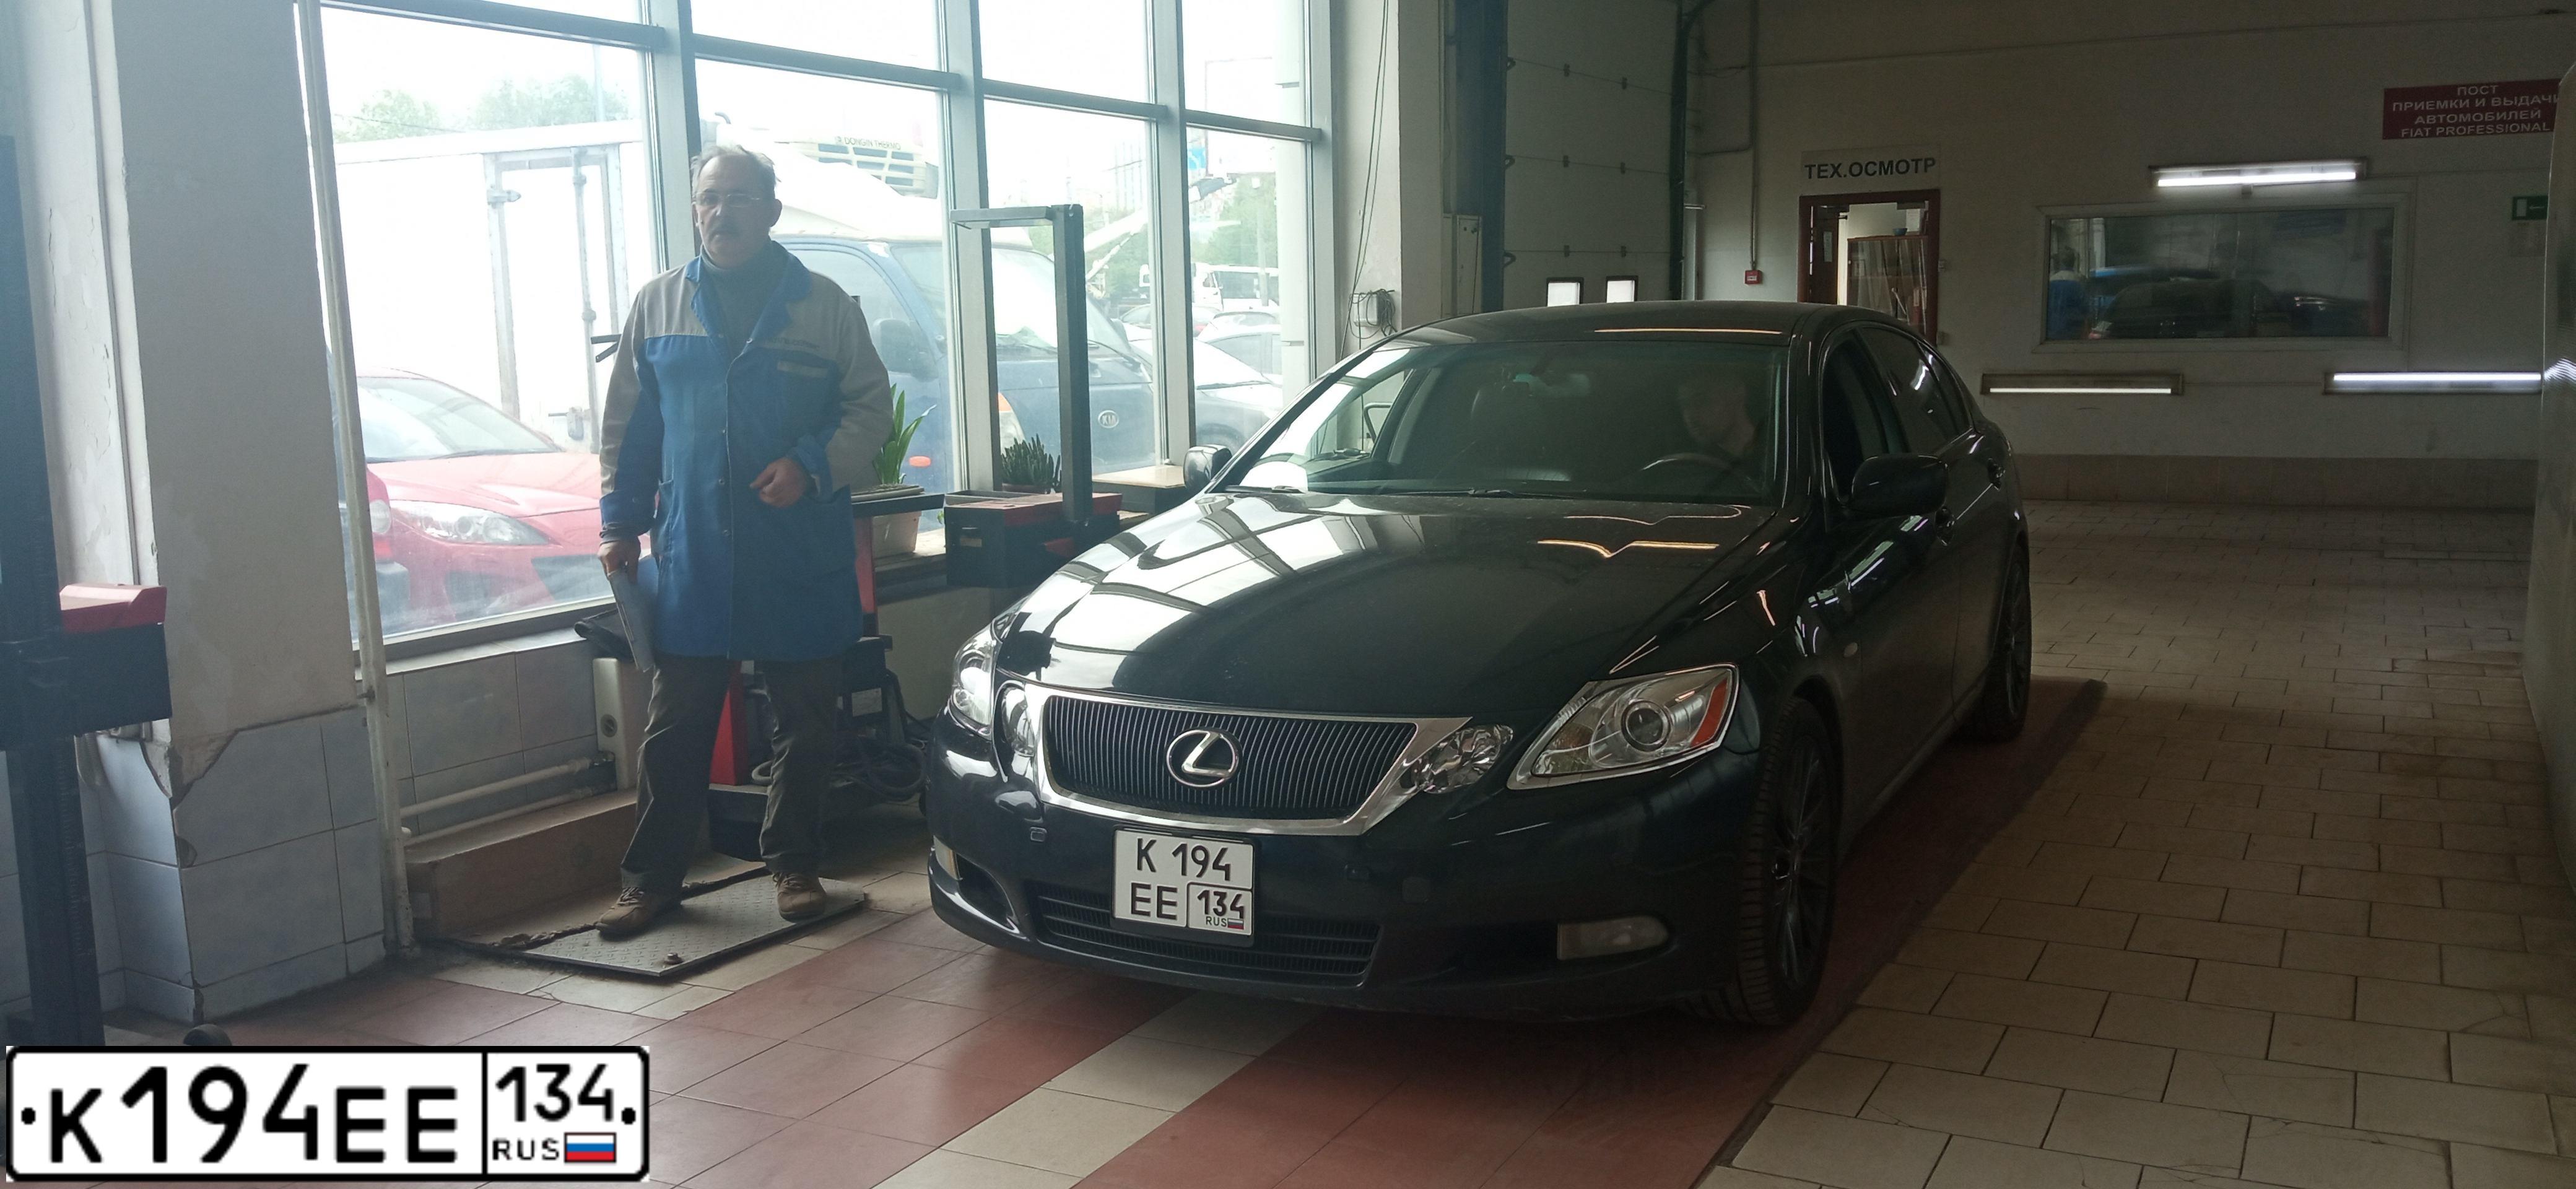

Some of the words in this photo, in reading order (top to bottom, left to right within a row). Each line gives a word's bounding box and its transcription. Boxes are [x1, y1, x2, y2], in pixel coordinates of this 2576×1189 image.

[2456, 85, 2499, 96] ПОСТ
[2392, 99, 2469, 111] ПРИЕМКИ
[2474, 97, 2486, 107] И
[2414, 108, 2542, 124] АВТОМОБИЛЕЙ
[2400, 128, 2432, 138] FIAT
[2435, 122, 2551, 136] PROFESSIONAL
[844, 137, 873, 147] DONGIN
[874, 139, 902, 150] THERMO
[1804, 157, 1936, 180] ТЕХ.ОСМОТР
[1172, 843, 1232, 882] 194
[1196, 889, 1245, 920] 134
[1205, 916, 1227, 928] RUS
